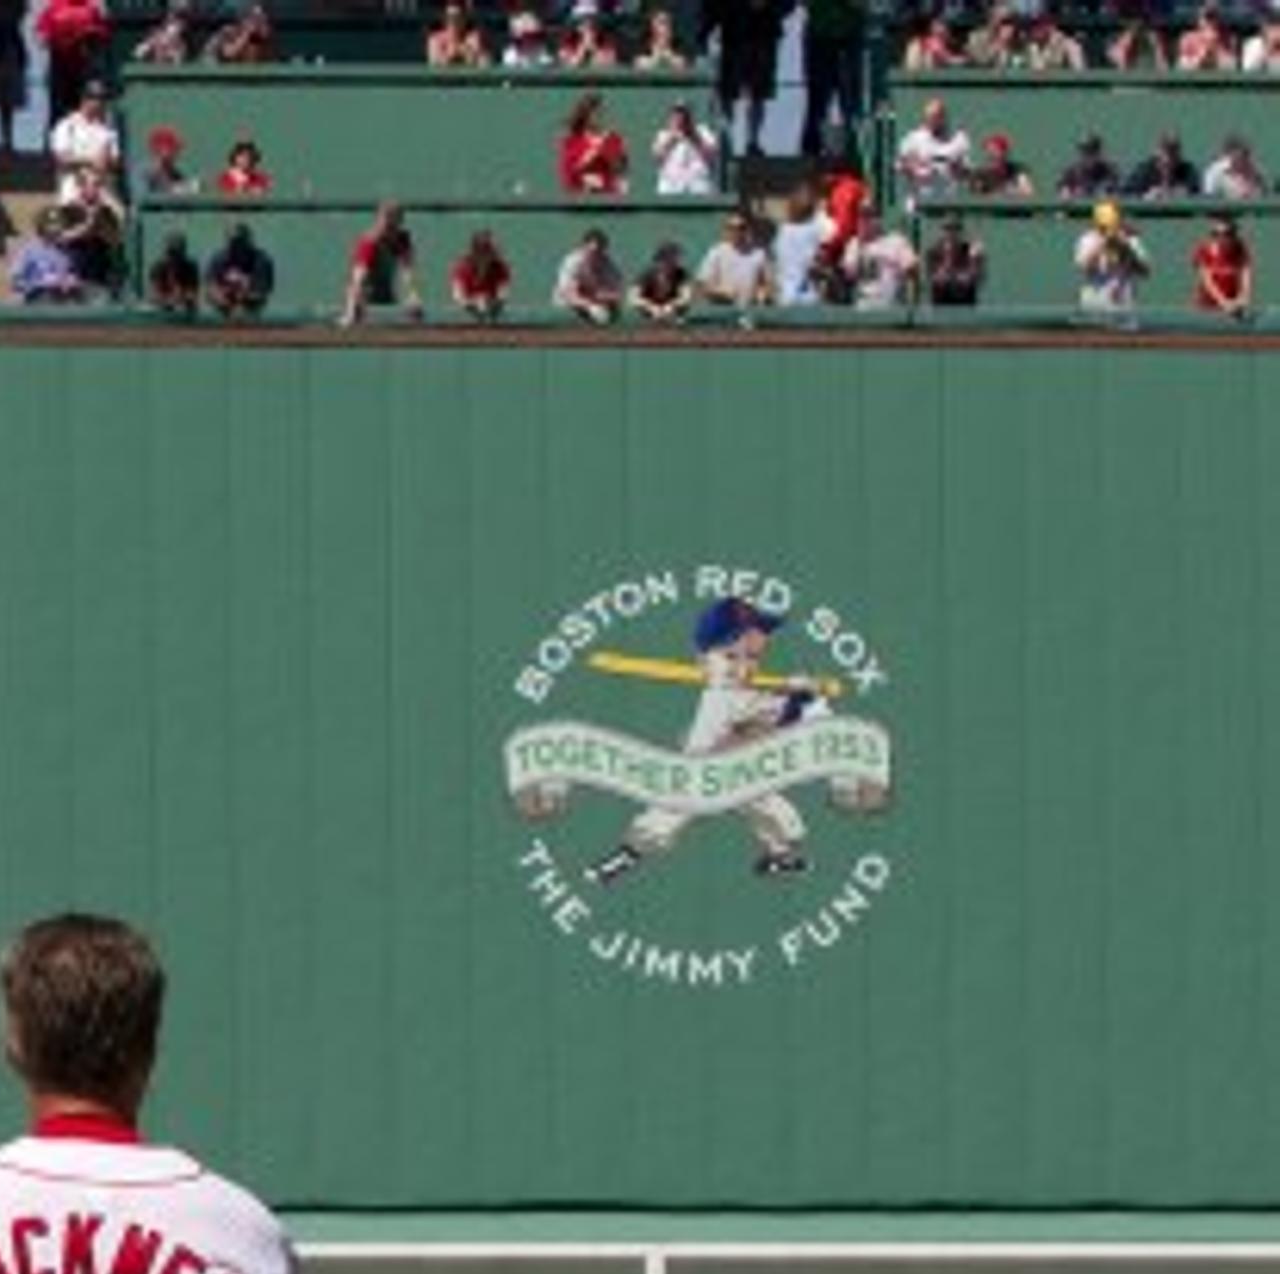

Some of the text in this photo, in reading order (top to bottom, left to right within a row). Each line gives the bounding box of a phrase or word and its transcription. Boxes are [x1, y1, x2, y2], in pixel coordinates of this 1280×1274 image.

[512, 565, 889, 704] BOSTON RED SOX
[518, 838, 892, 985] THE JIMMY FUND
